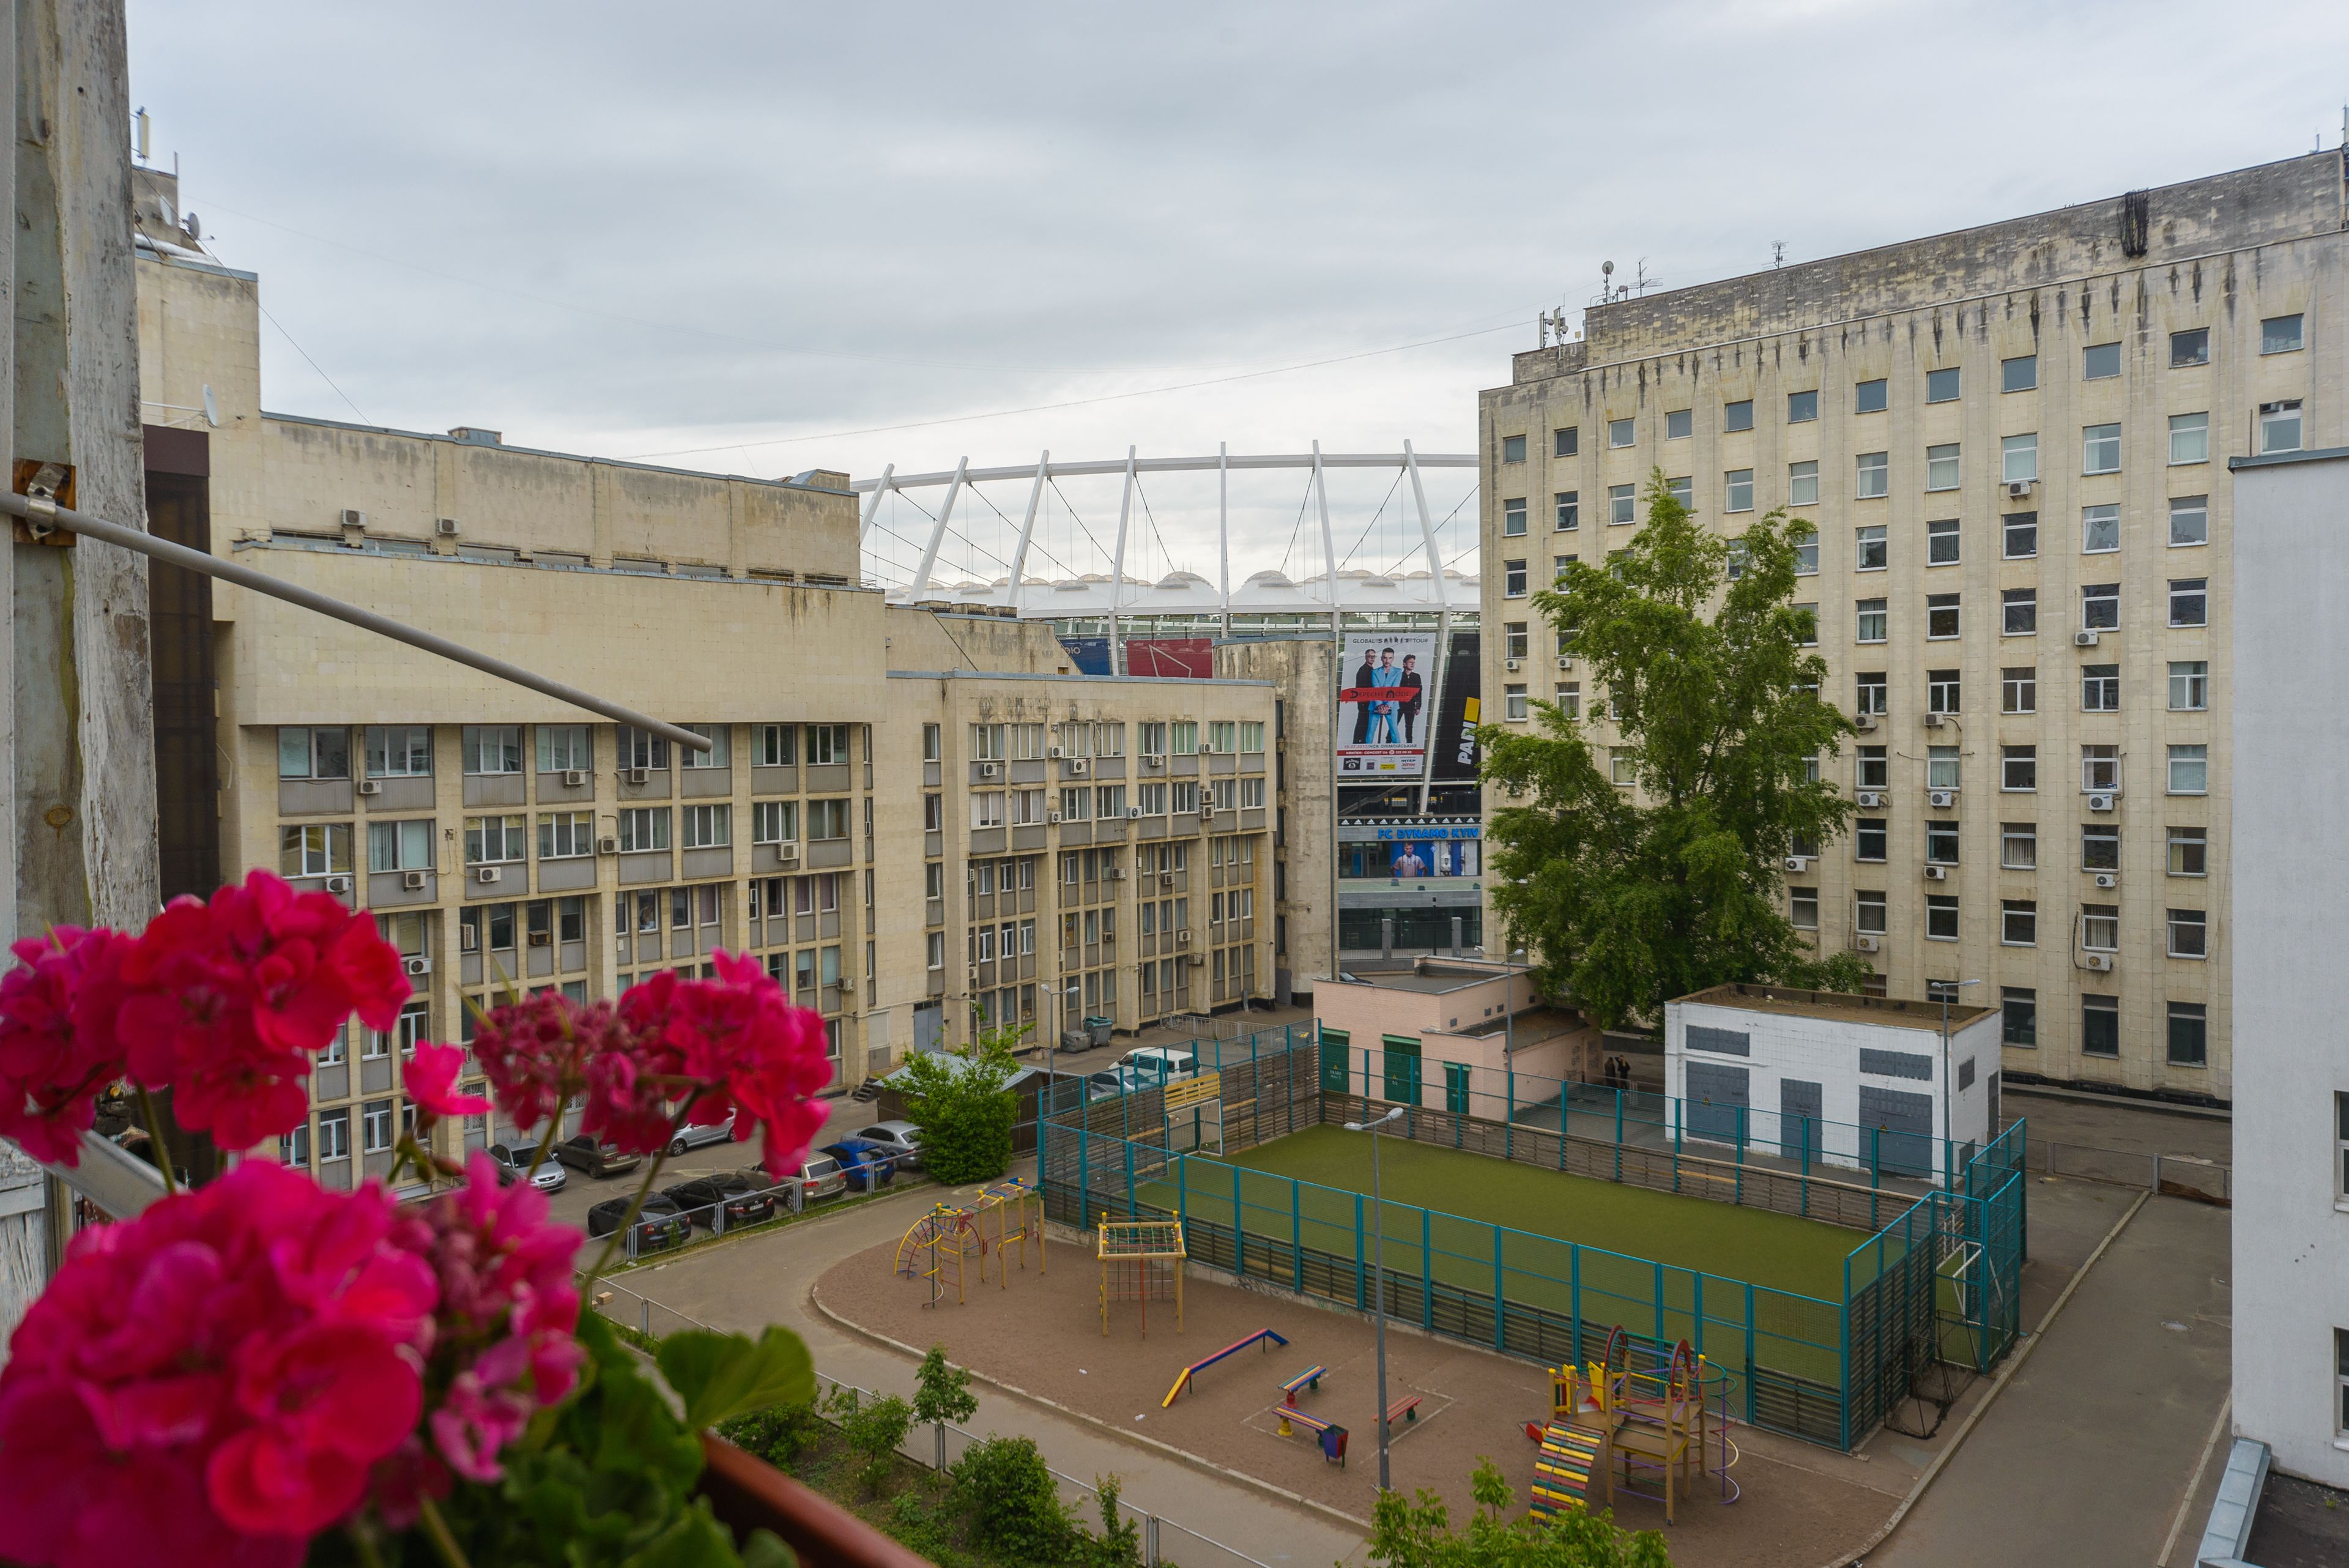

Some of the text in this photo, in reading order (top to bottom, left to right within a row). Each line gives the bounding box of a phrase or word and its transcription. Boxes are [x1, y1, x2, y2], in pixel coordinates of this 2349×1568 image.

[1378, 827, 1479, 839] FC DYNAMO KYIV
